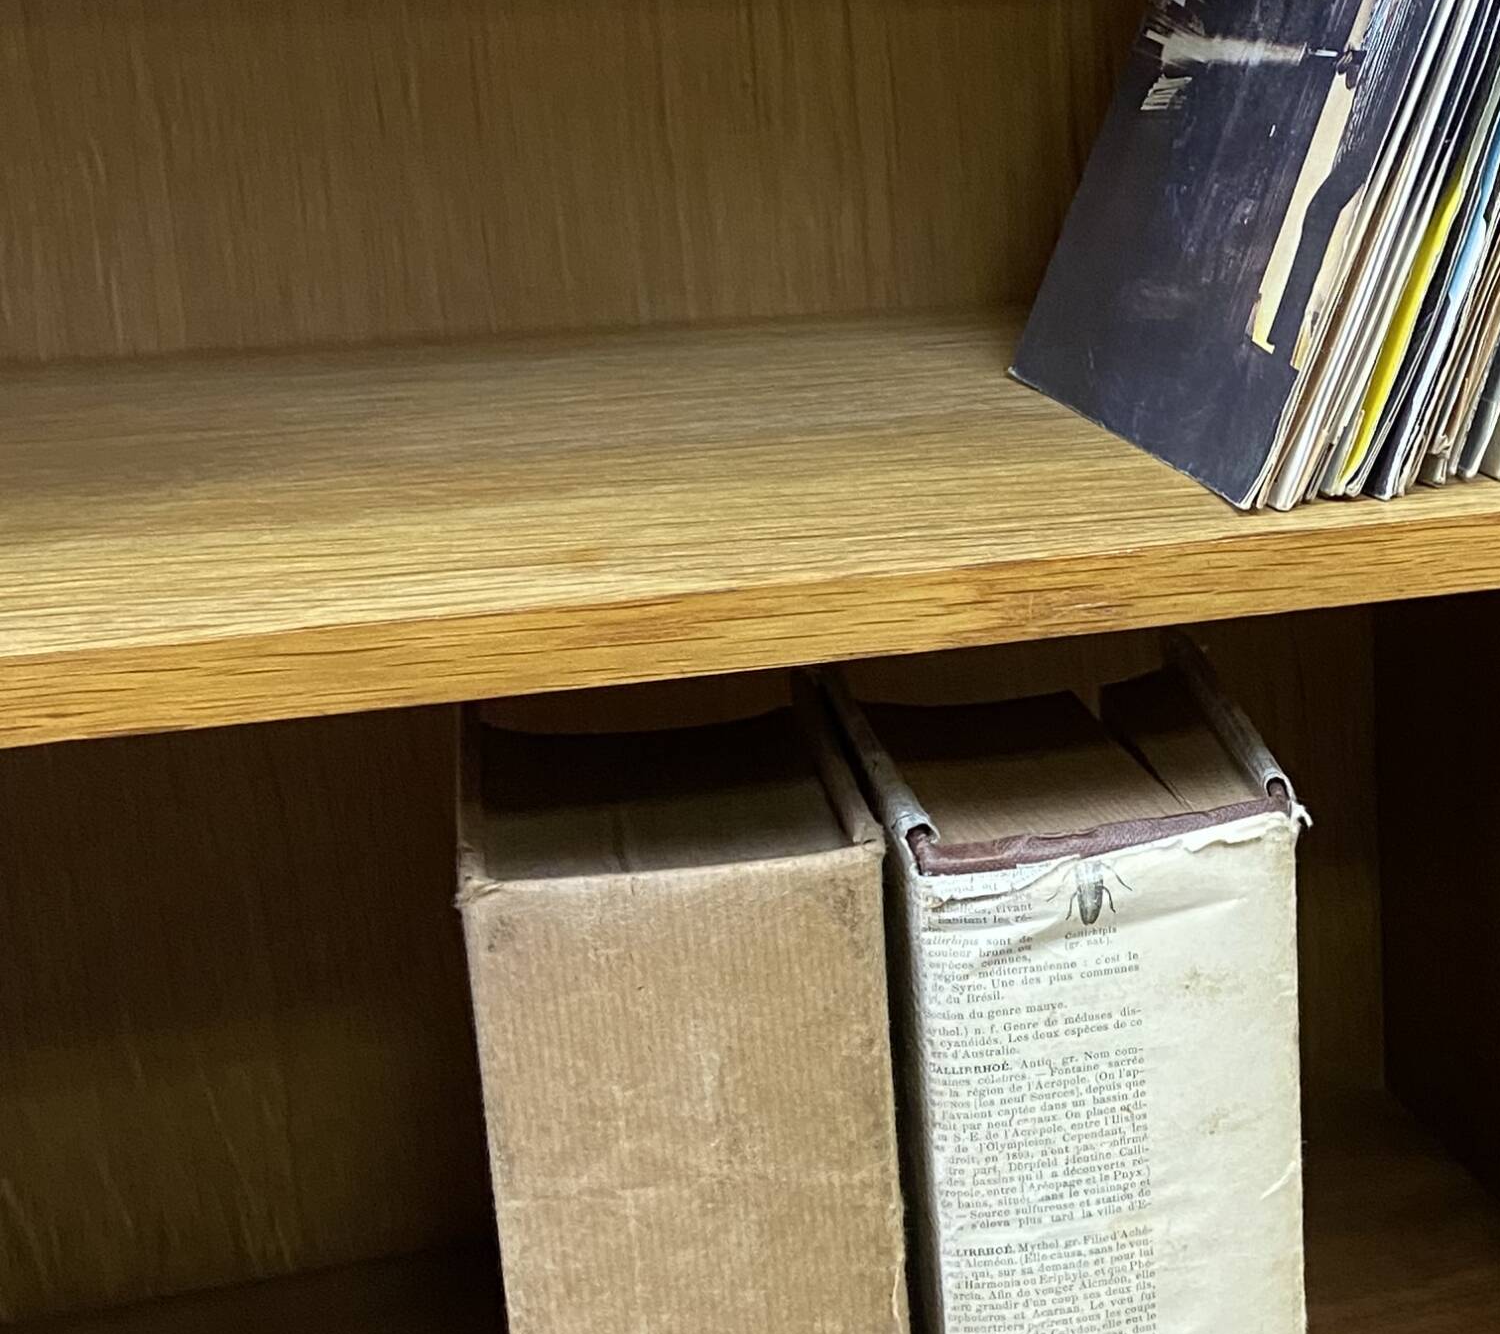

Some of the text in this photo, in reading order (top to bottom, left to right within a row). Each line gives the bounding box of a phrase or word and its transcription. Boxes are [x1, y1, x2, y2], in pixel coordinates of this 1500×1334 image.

[1079, 963, 1139, 978] communes
[987, 1007, 1021, 1020] genre
[1003, 1020, 1038, 1032] Genre
[1064, 1010, 1112, 1024] méduses
